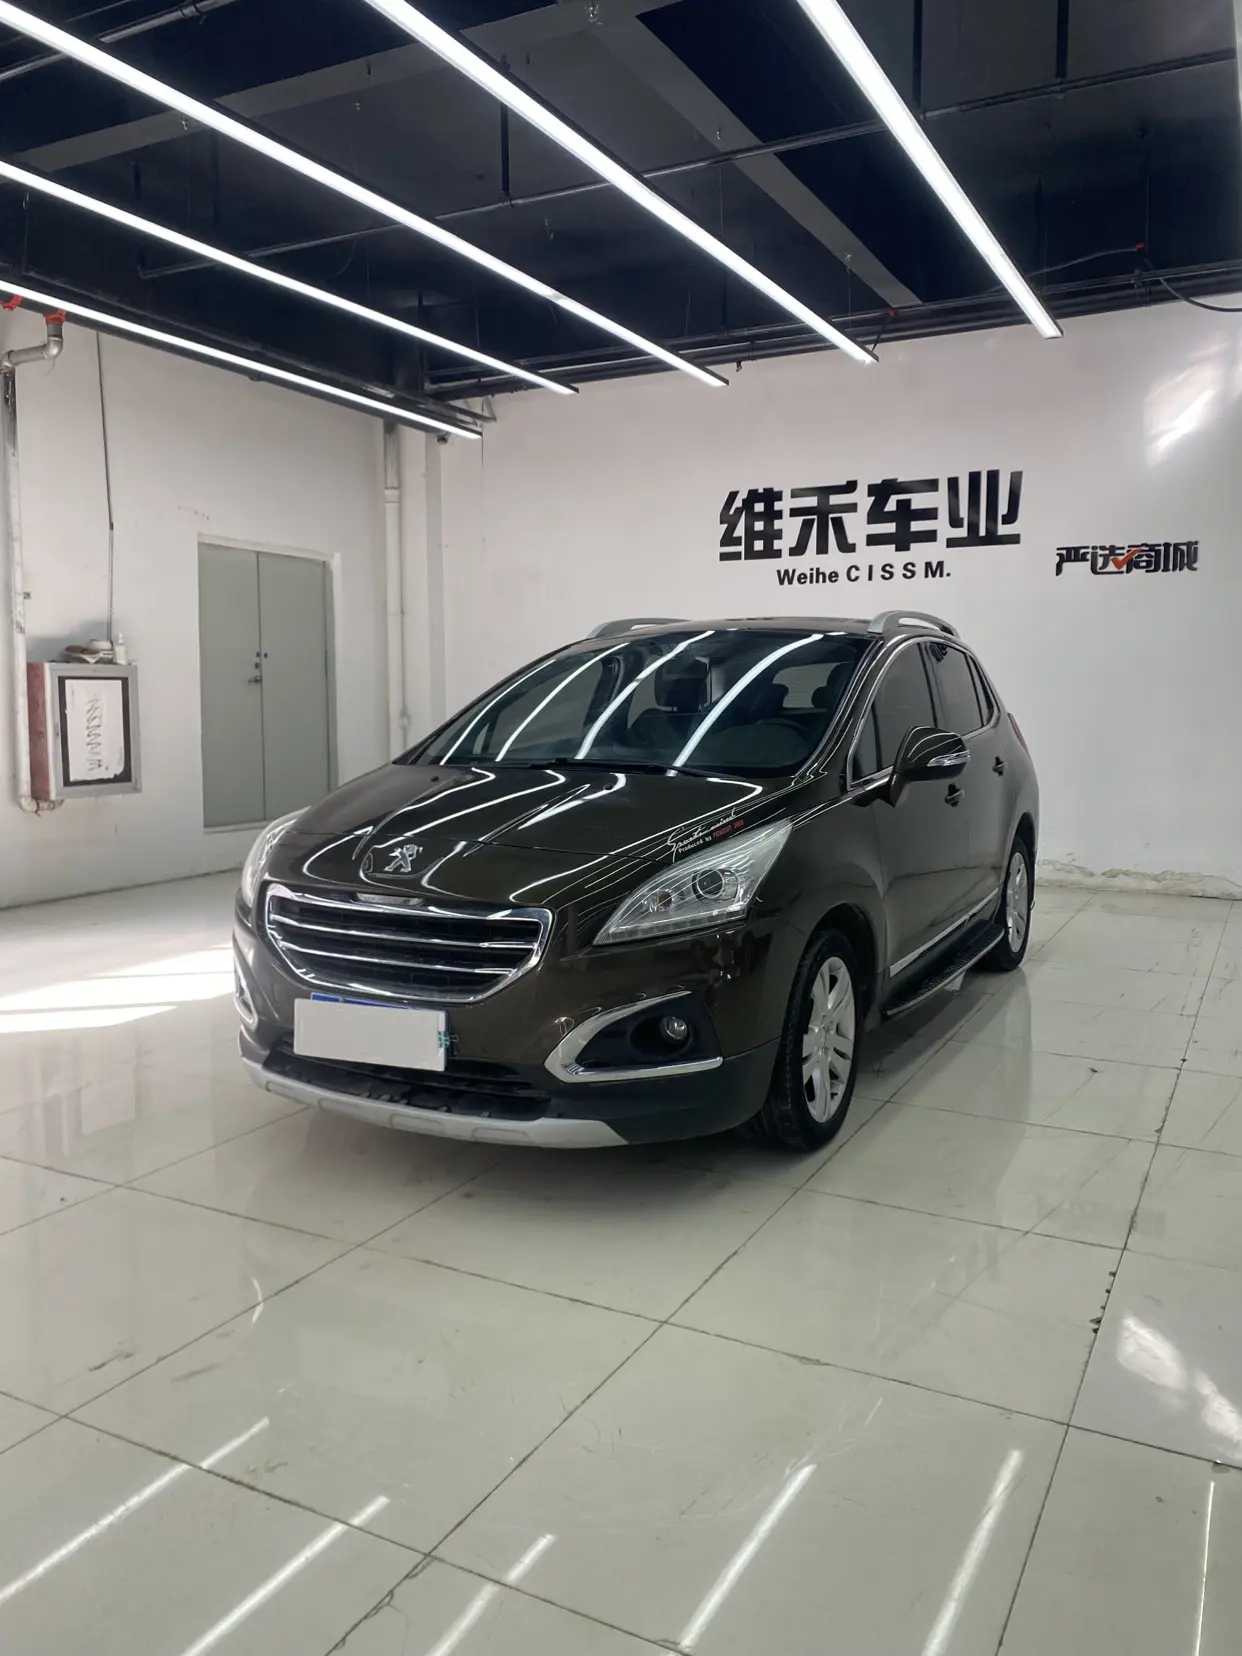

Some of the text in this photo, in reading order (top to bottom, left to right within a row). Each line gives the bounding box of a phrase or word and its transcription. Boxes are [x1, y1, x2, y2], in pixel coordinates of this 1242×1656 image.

[719, 469, 1023, 561] 维禾车业
[1055, 541, 1199, 576] 严选商城
[776, 567, 839, 585] Weihe
[678, 839, 703, 853] Produced
